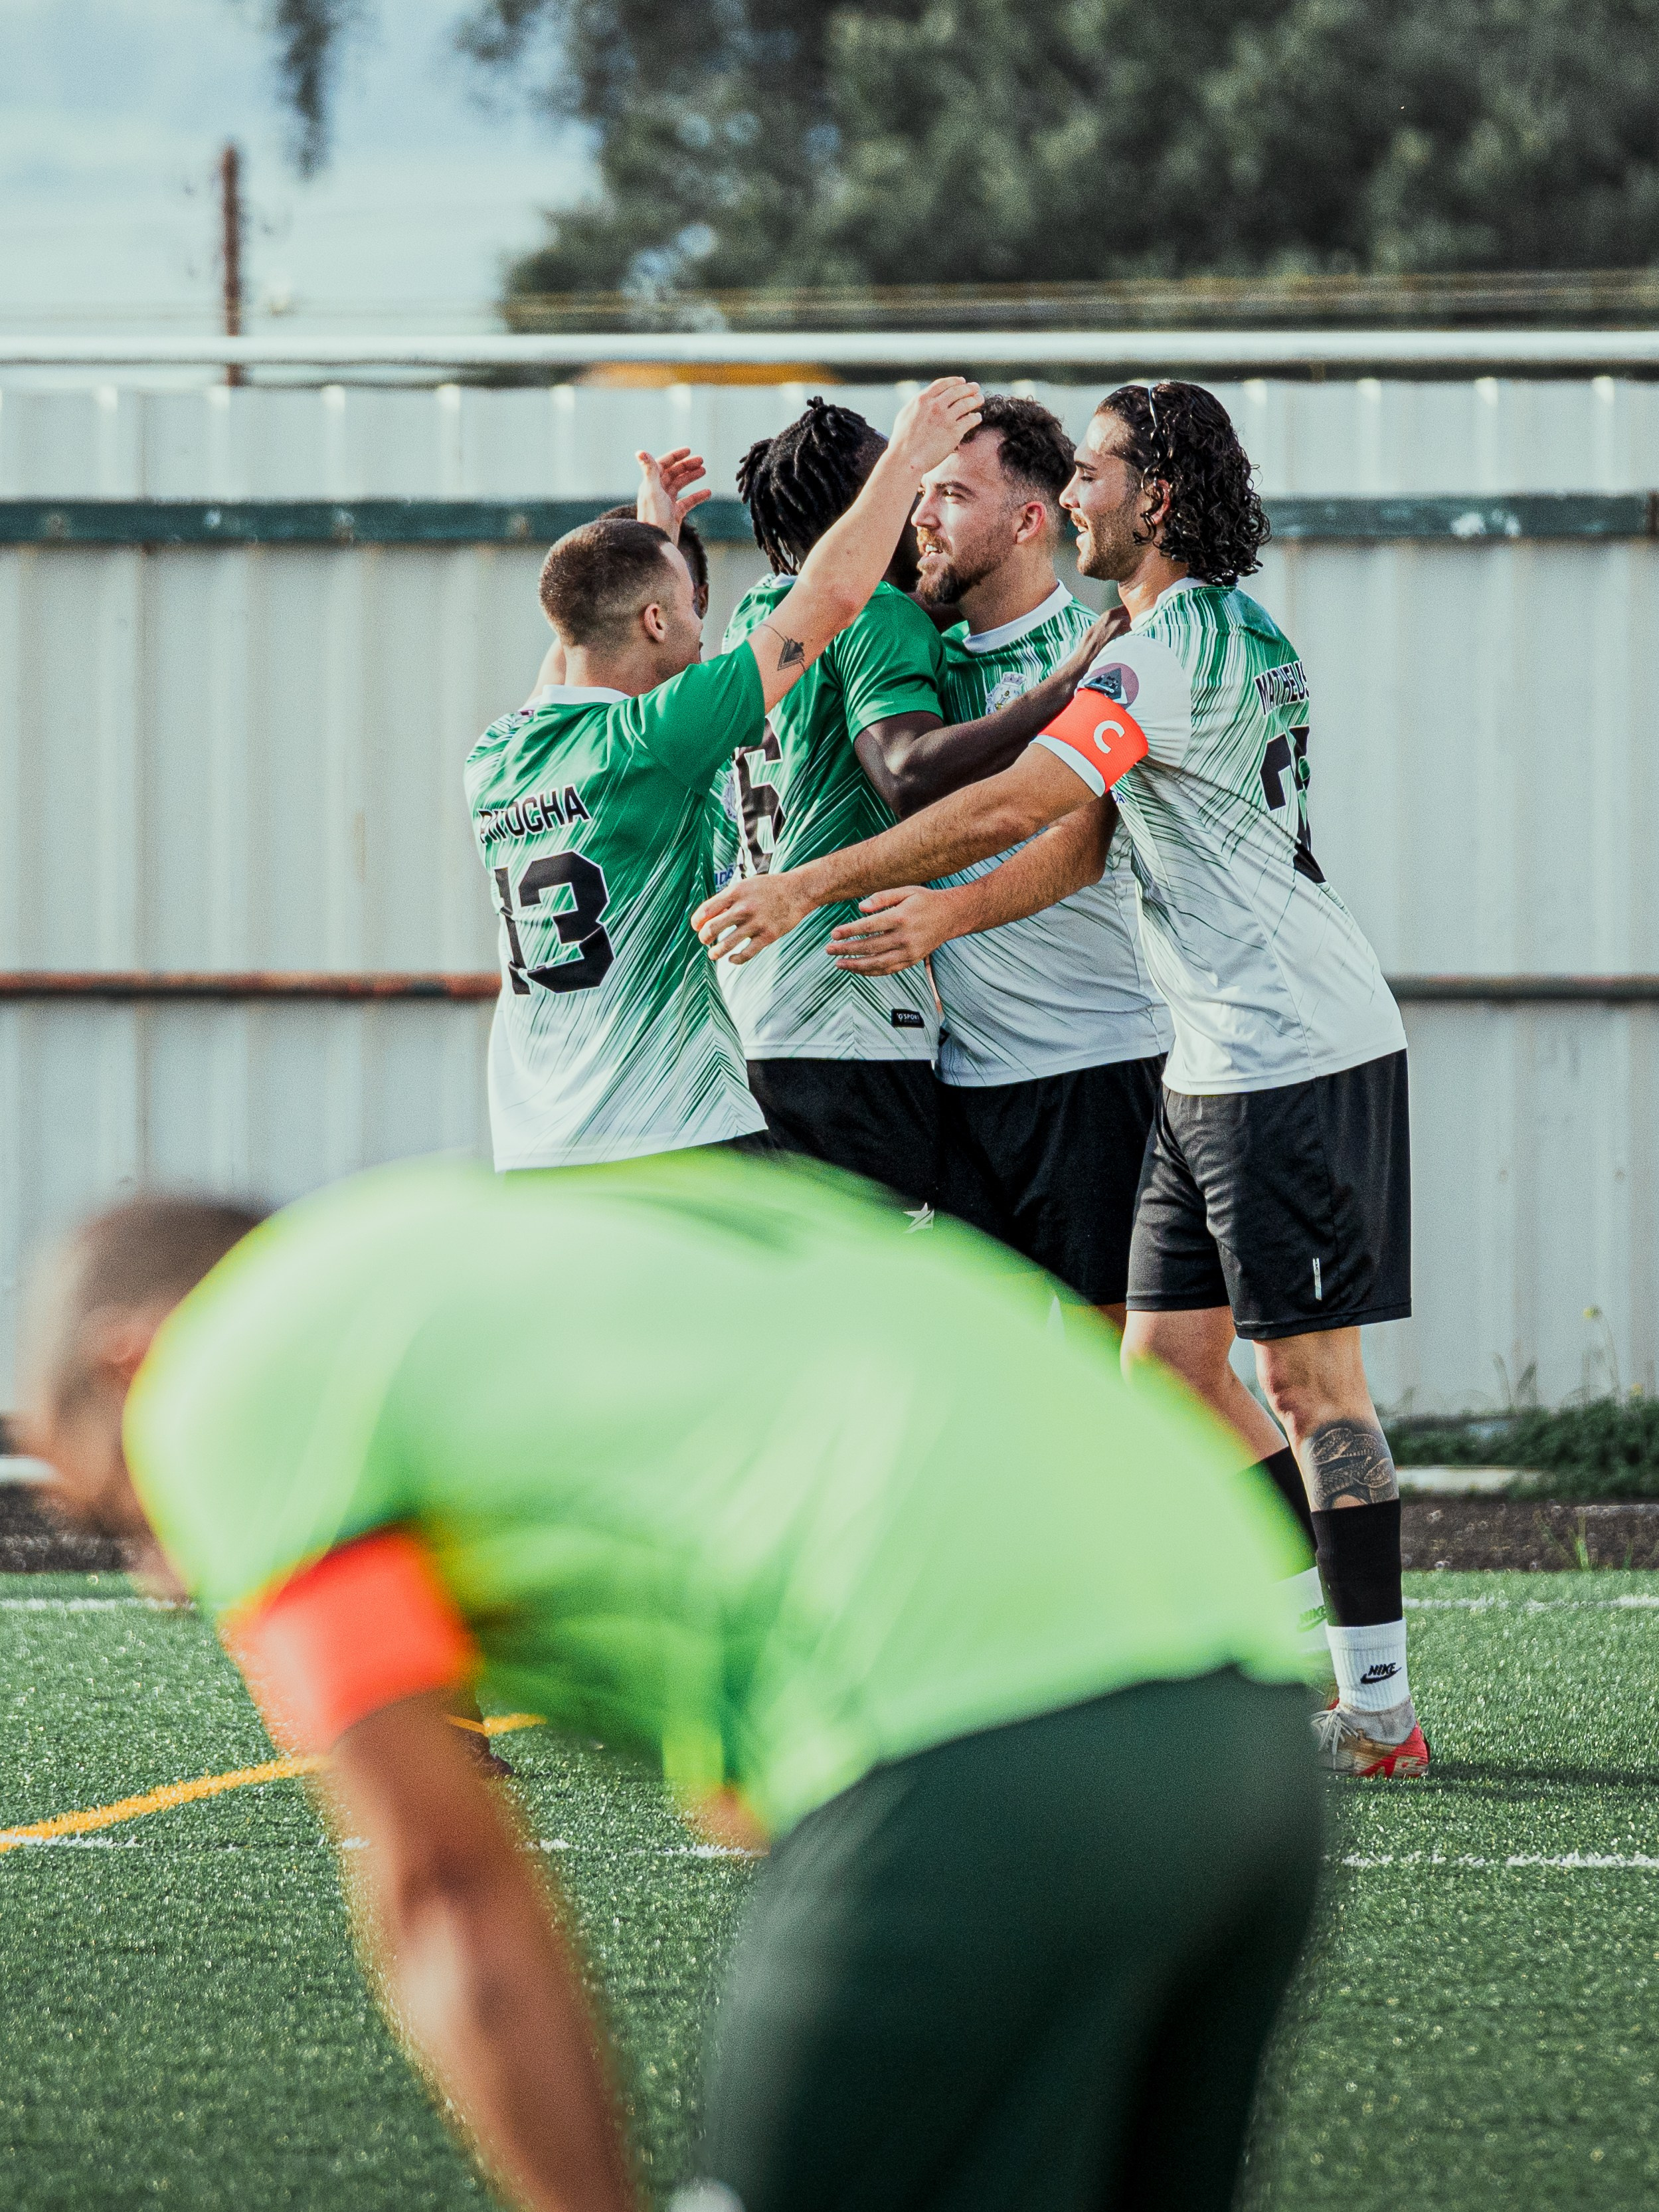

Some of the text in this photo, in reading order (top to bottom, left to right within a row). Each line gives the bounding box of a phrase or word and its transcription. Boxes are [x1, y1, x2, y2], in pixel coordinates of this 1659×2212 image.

[1093, 720, 1125, 754] C
[493, 849, 616, 995] 13
[1368, 1662, 1396, 1676] NIKE
